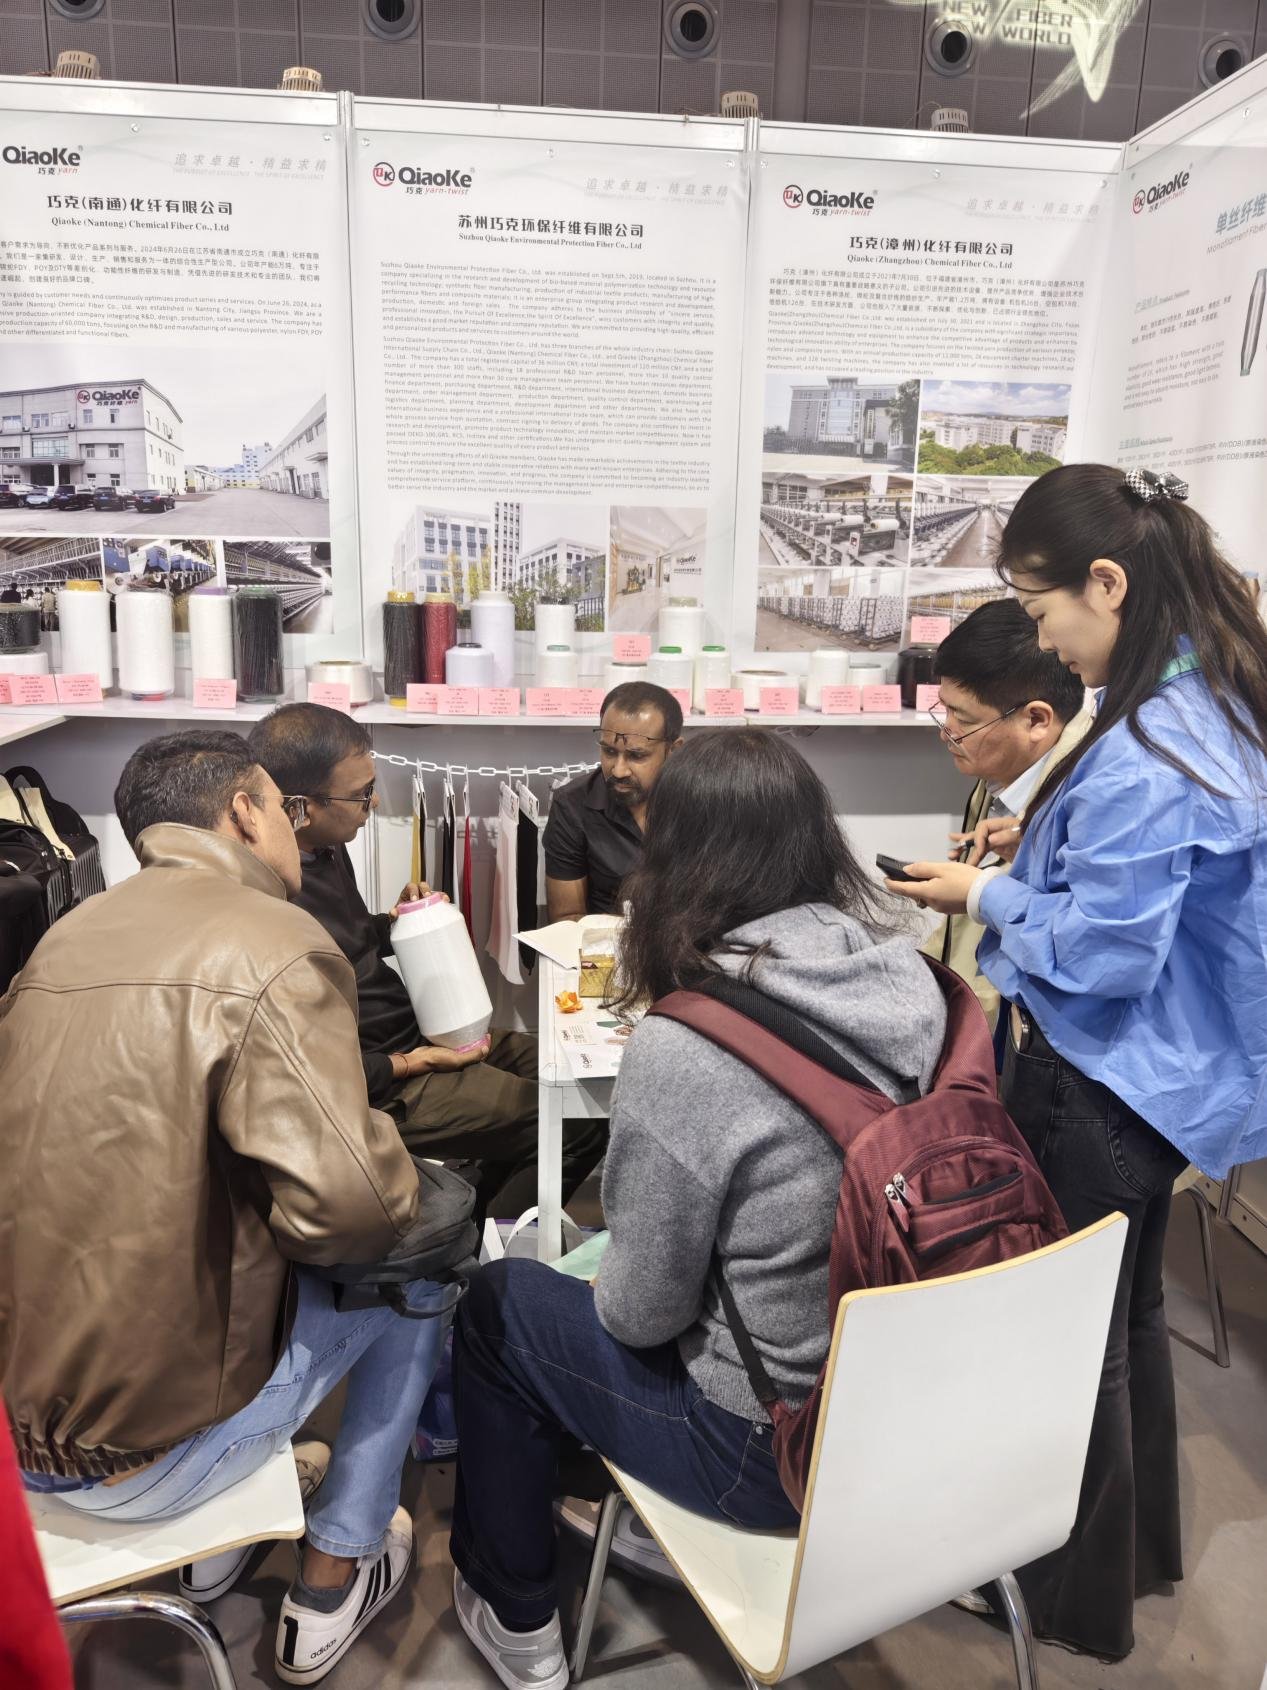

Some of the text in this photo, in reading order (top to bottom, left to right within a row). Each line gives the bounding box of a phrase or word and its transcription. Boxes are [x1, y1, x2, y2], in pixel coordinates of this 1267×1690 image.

[1002, 24, 1072, 45] WORLD
[3, 146, 81, 167] QiaoKe
[38, 167, 55, 176] 巧克
[398, 167, 472, 188] QiaoKe
[405, 186, 423, 195] 巧克
[424, 187, 469, 195] yarn-twist
[1146, 171, 1190, 205] QiaoKe
[806, 189, 875, 209] QiaoKe
[812, 208, 828, 216] 巧克
[51, 217, 82, 227] Qiaoke
[84, 218, 127, 229] (Nantong)
[129, 220, 169, 230] Chemical
[170, 222, 194, 231] Fiber
[214, 224, 230, 232] Ltd
[458, 214, 644, 238] 苏州巧克环保纤维有限公司
[458, 233, 484, 242] Suzhou
[485, 234, 509, 243] Qiaoke
[510, 236, 560, 246] Environmental
[561, 238, 595, 248] Protection
[596, 240, 614, 249] Fiber
[630, 242, 642, 250] Ltd
[847, 255, 874, 264] Qiaoke
[924, 257, 960, 267] Chemical
[961, 259, 982, 268] Fiber
[999, 261, 1013, 270] Ltd
[92, 389, 140, 402] QiaoKe
[310, 1638, 337, 1659] adidas
